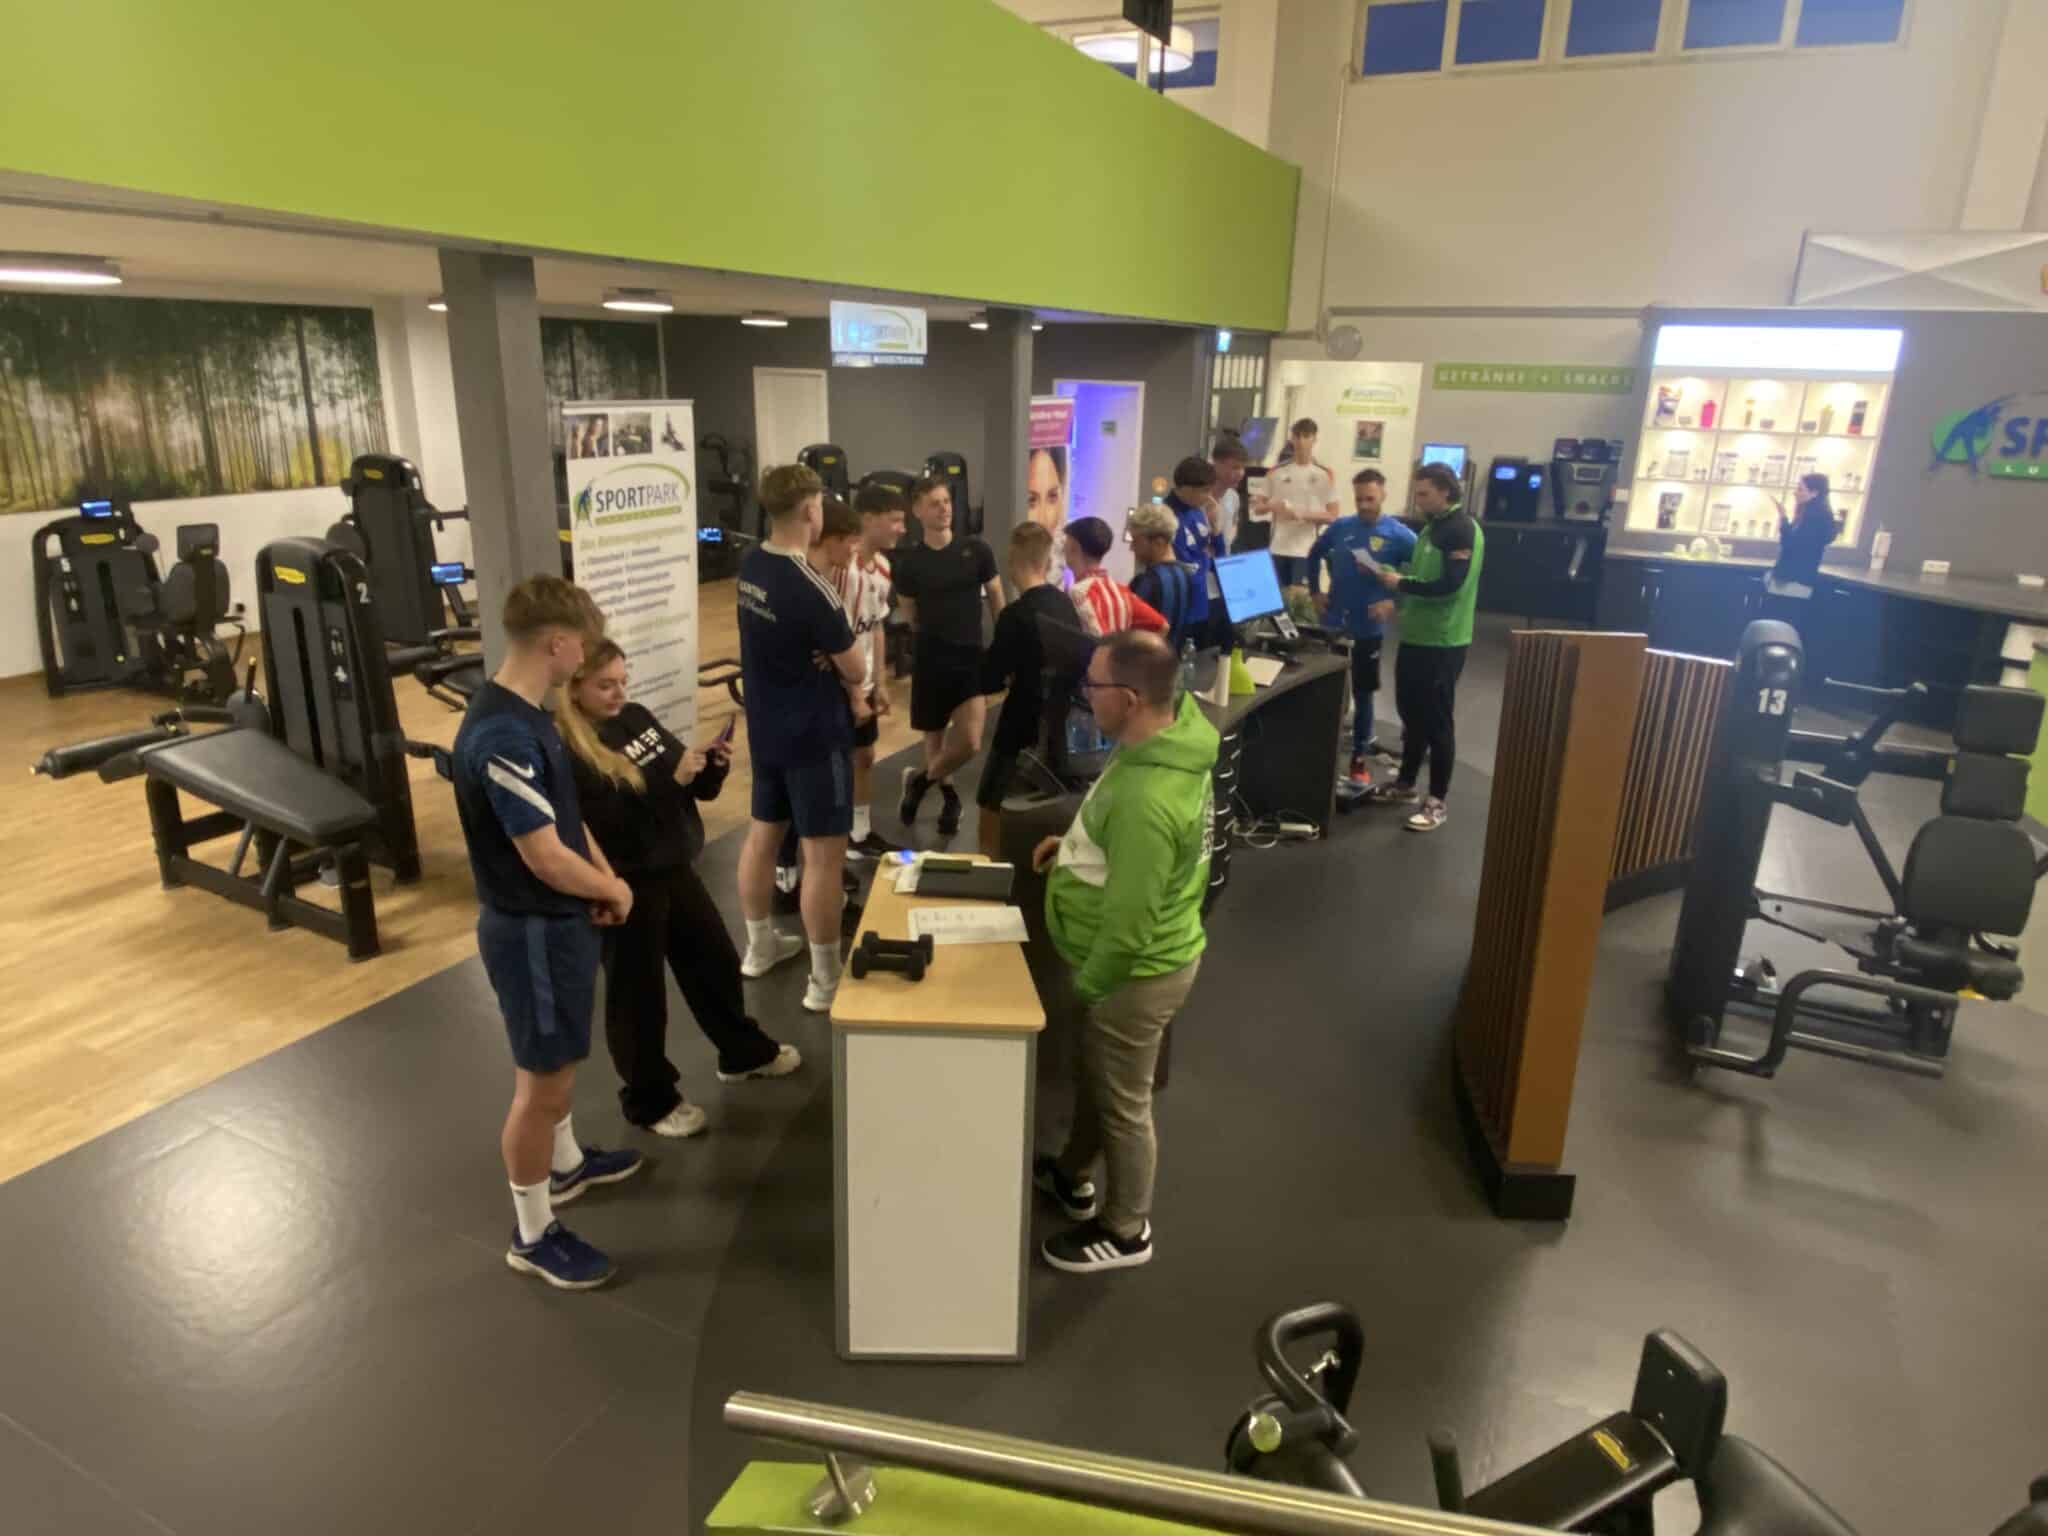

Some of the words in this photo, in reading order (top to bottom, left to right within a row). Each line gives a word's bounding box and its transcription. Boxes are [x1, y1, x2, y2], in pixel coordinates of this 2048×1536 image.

[595, 482, 681, 513] SPORTPARK
[356, 582, 370, 604] 2
[1758, 687, 1788, 716] 13
